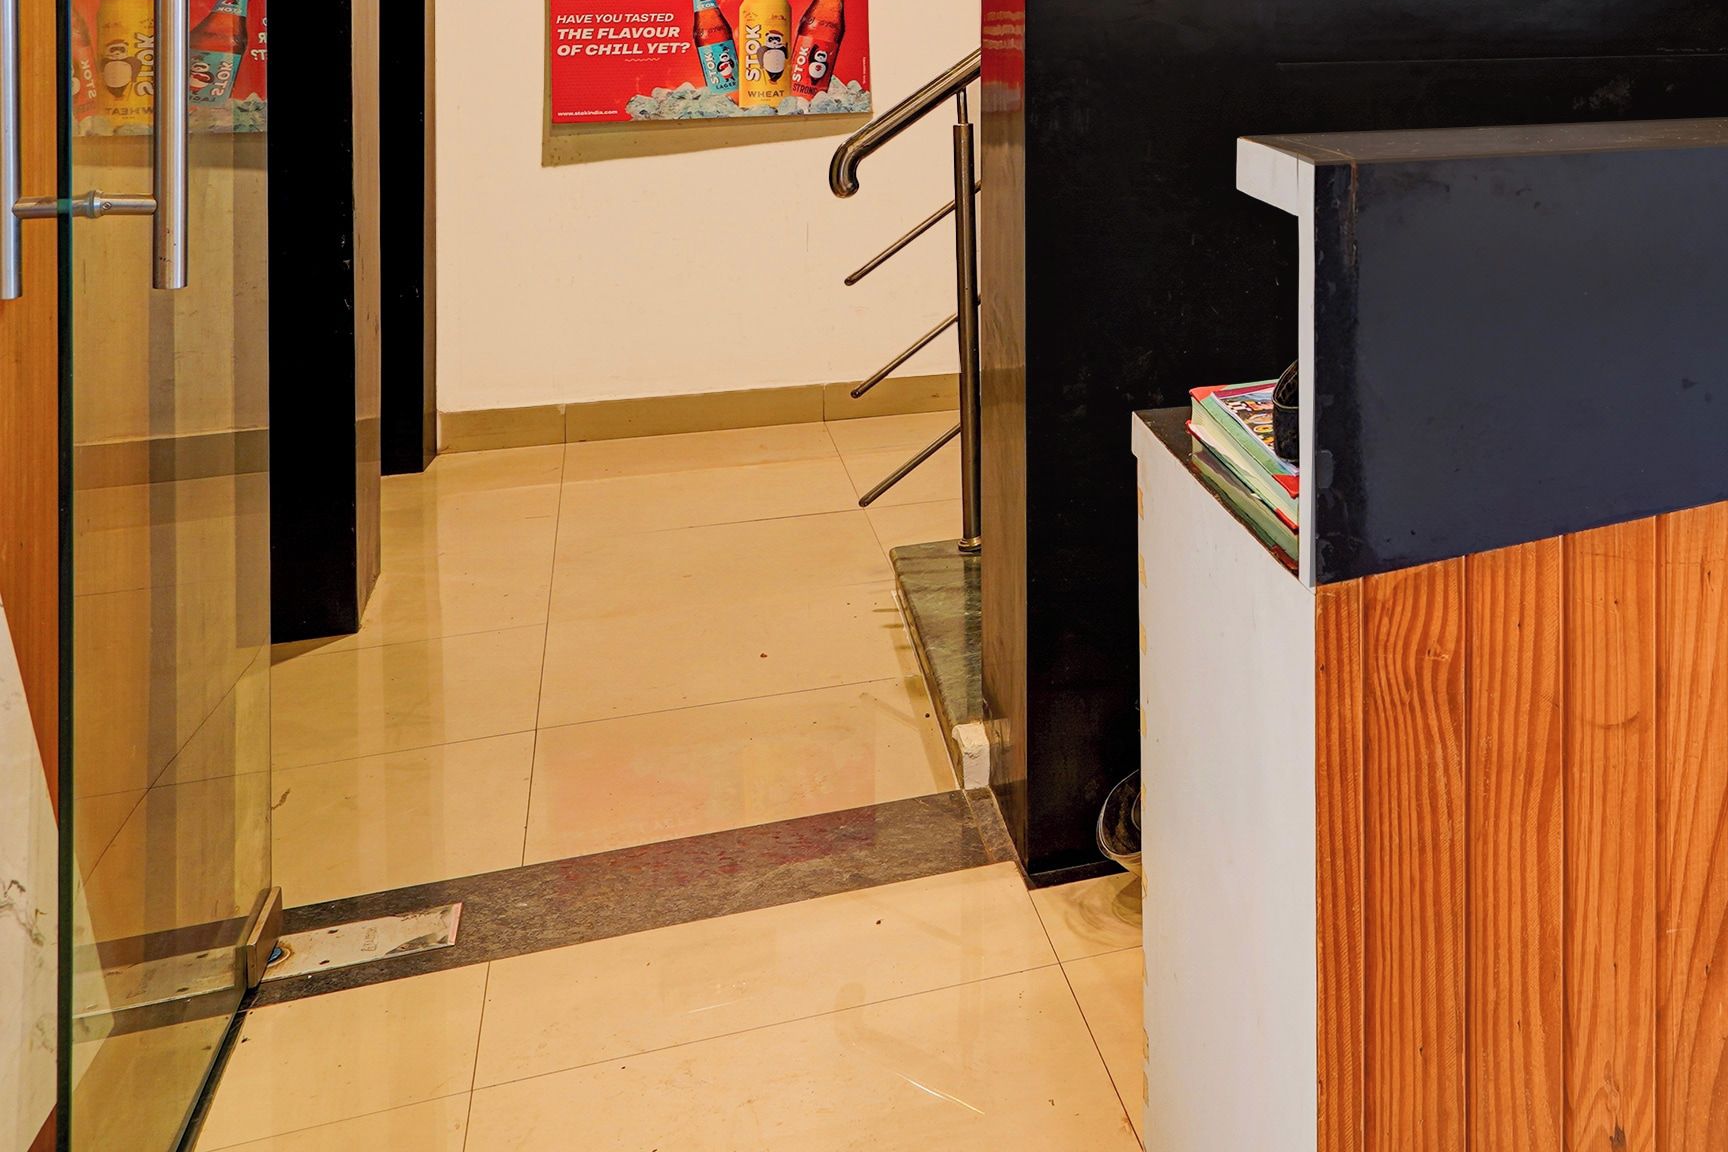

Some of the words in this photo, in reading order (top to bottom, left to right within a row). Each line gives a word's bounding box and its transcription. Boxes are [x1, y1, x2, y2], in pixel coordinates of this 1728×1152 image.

[556, 14, 594, 24] HAVE
[595, 13, 623, 23] YOU
[624, 13, 675, 23] TASTED
[557, 28, 596, 40] THE
[597, 26, 681, 39] FLAVOUR
[557, 45, 583, 56] OF
[585, 43, 644, 56] CHILL
[646, 42, 691, 54] YET?
[744, 24, 762, 82] STOK
[704, 51, 721, 85] STOK
[792, 47, 809, 82] STOK
[747, 90, 785, 98] WHEAT
